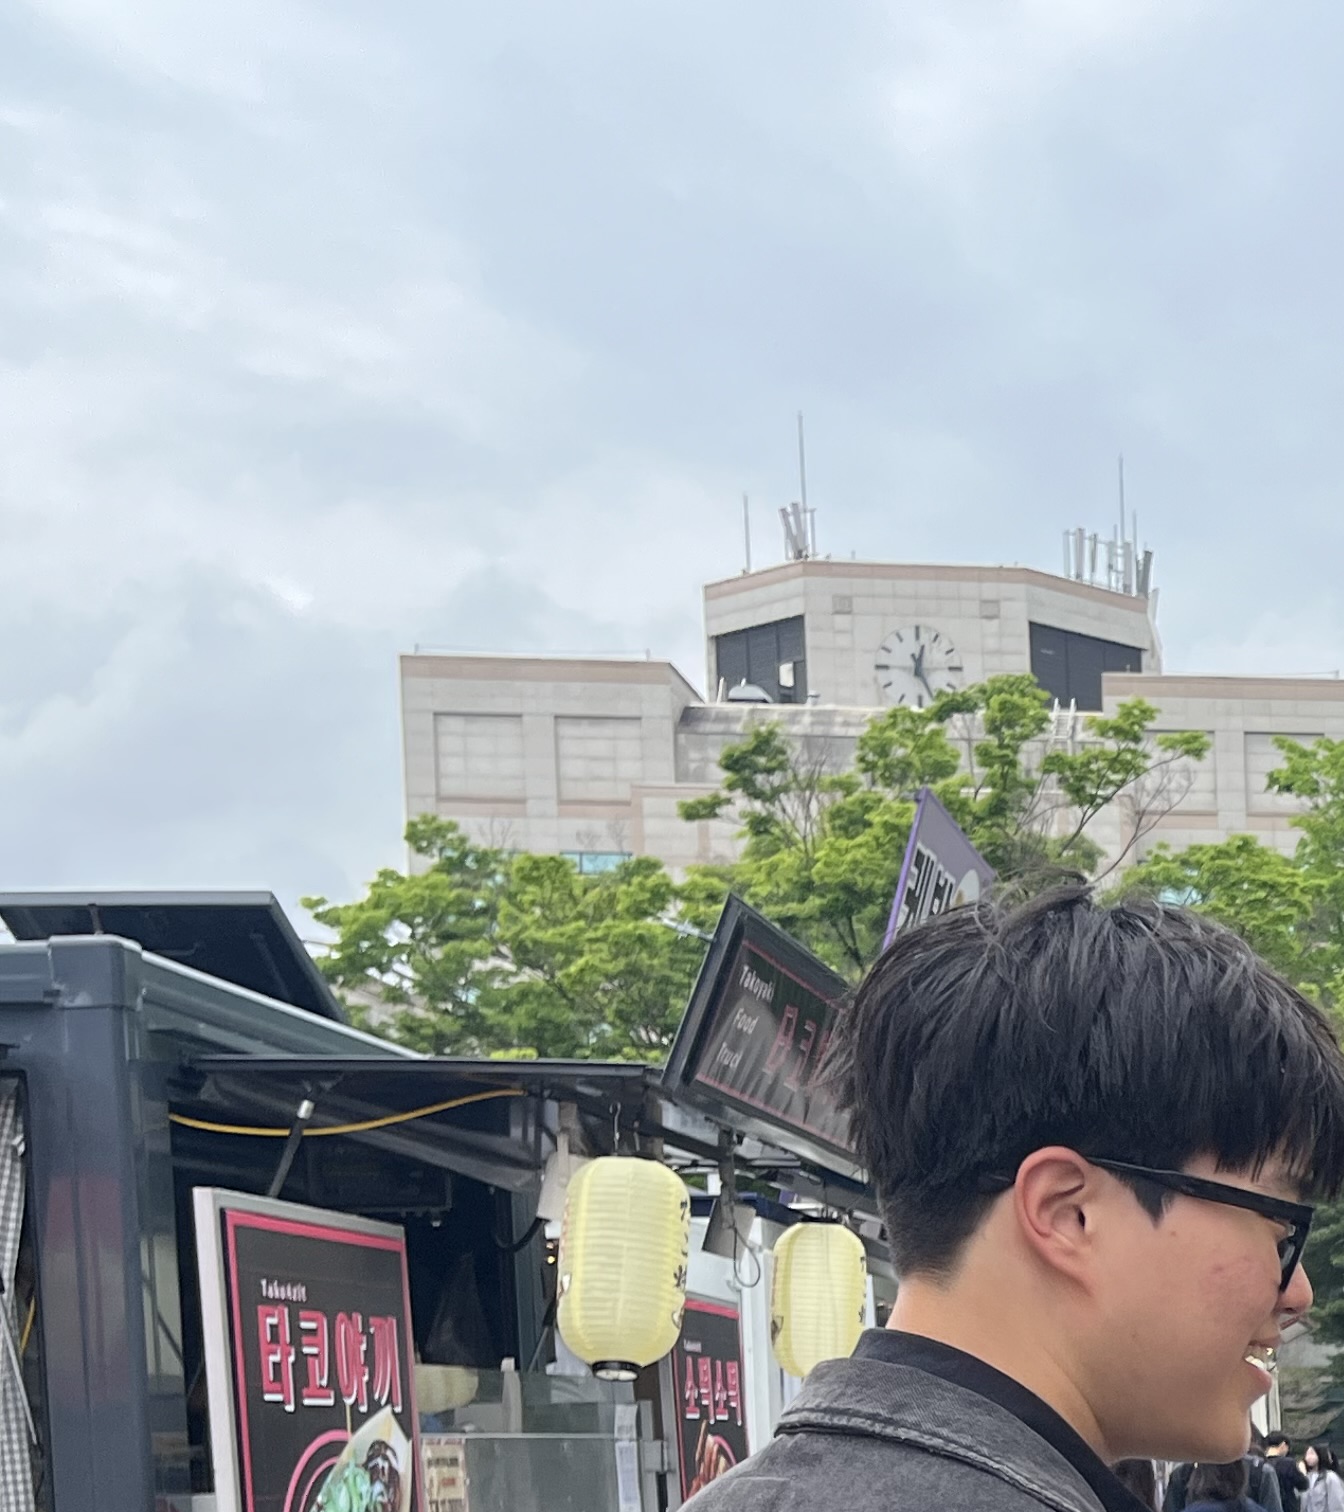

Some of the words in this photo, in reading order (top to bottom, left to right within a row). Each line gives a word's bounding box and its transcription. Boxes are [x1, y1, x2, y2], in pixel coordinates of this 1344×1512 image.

[739, 964, 775, 1001] Takoyaki
[733, 1007, 759, 1035] Food
[256, 1303, 403, 1414] 타코야끼
[684, 1354, 743, 1427] 소떡소떡
